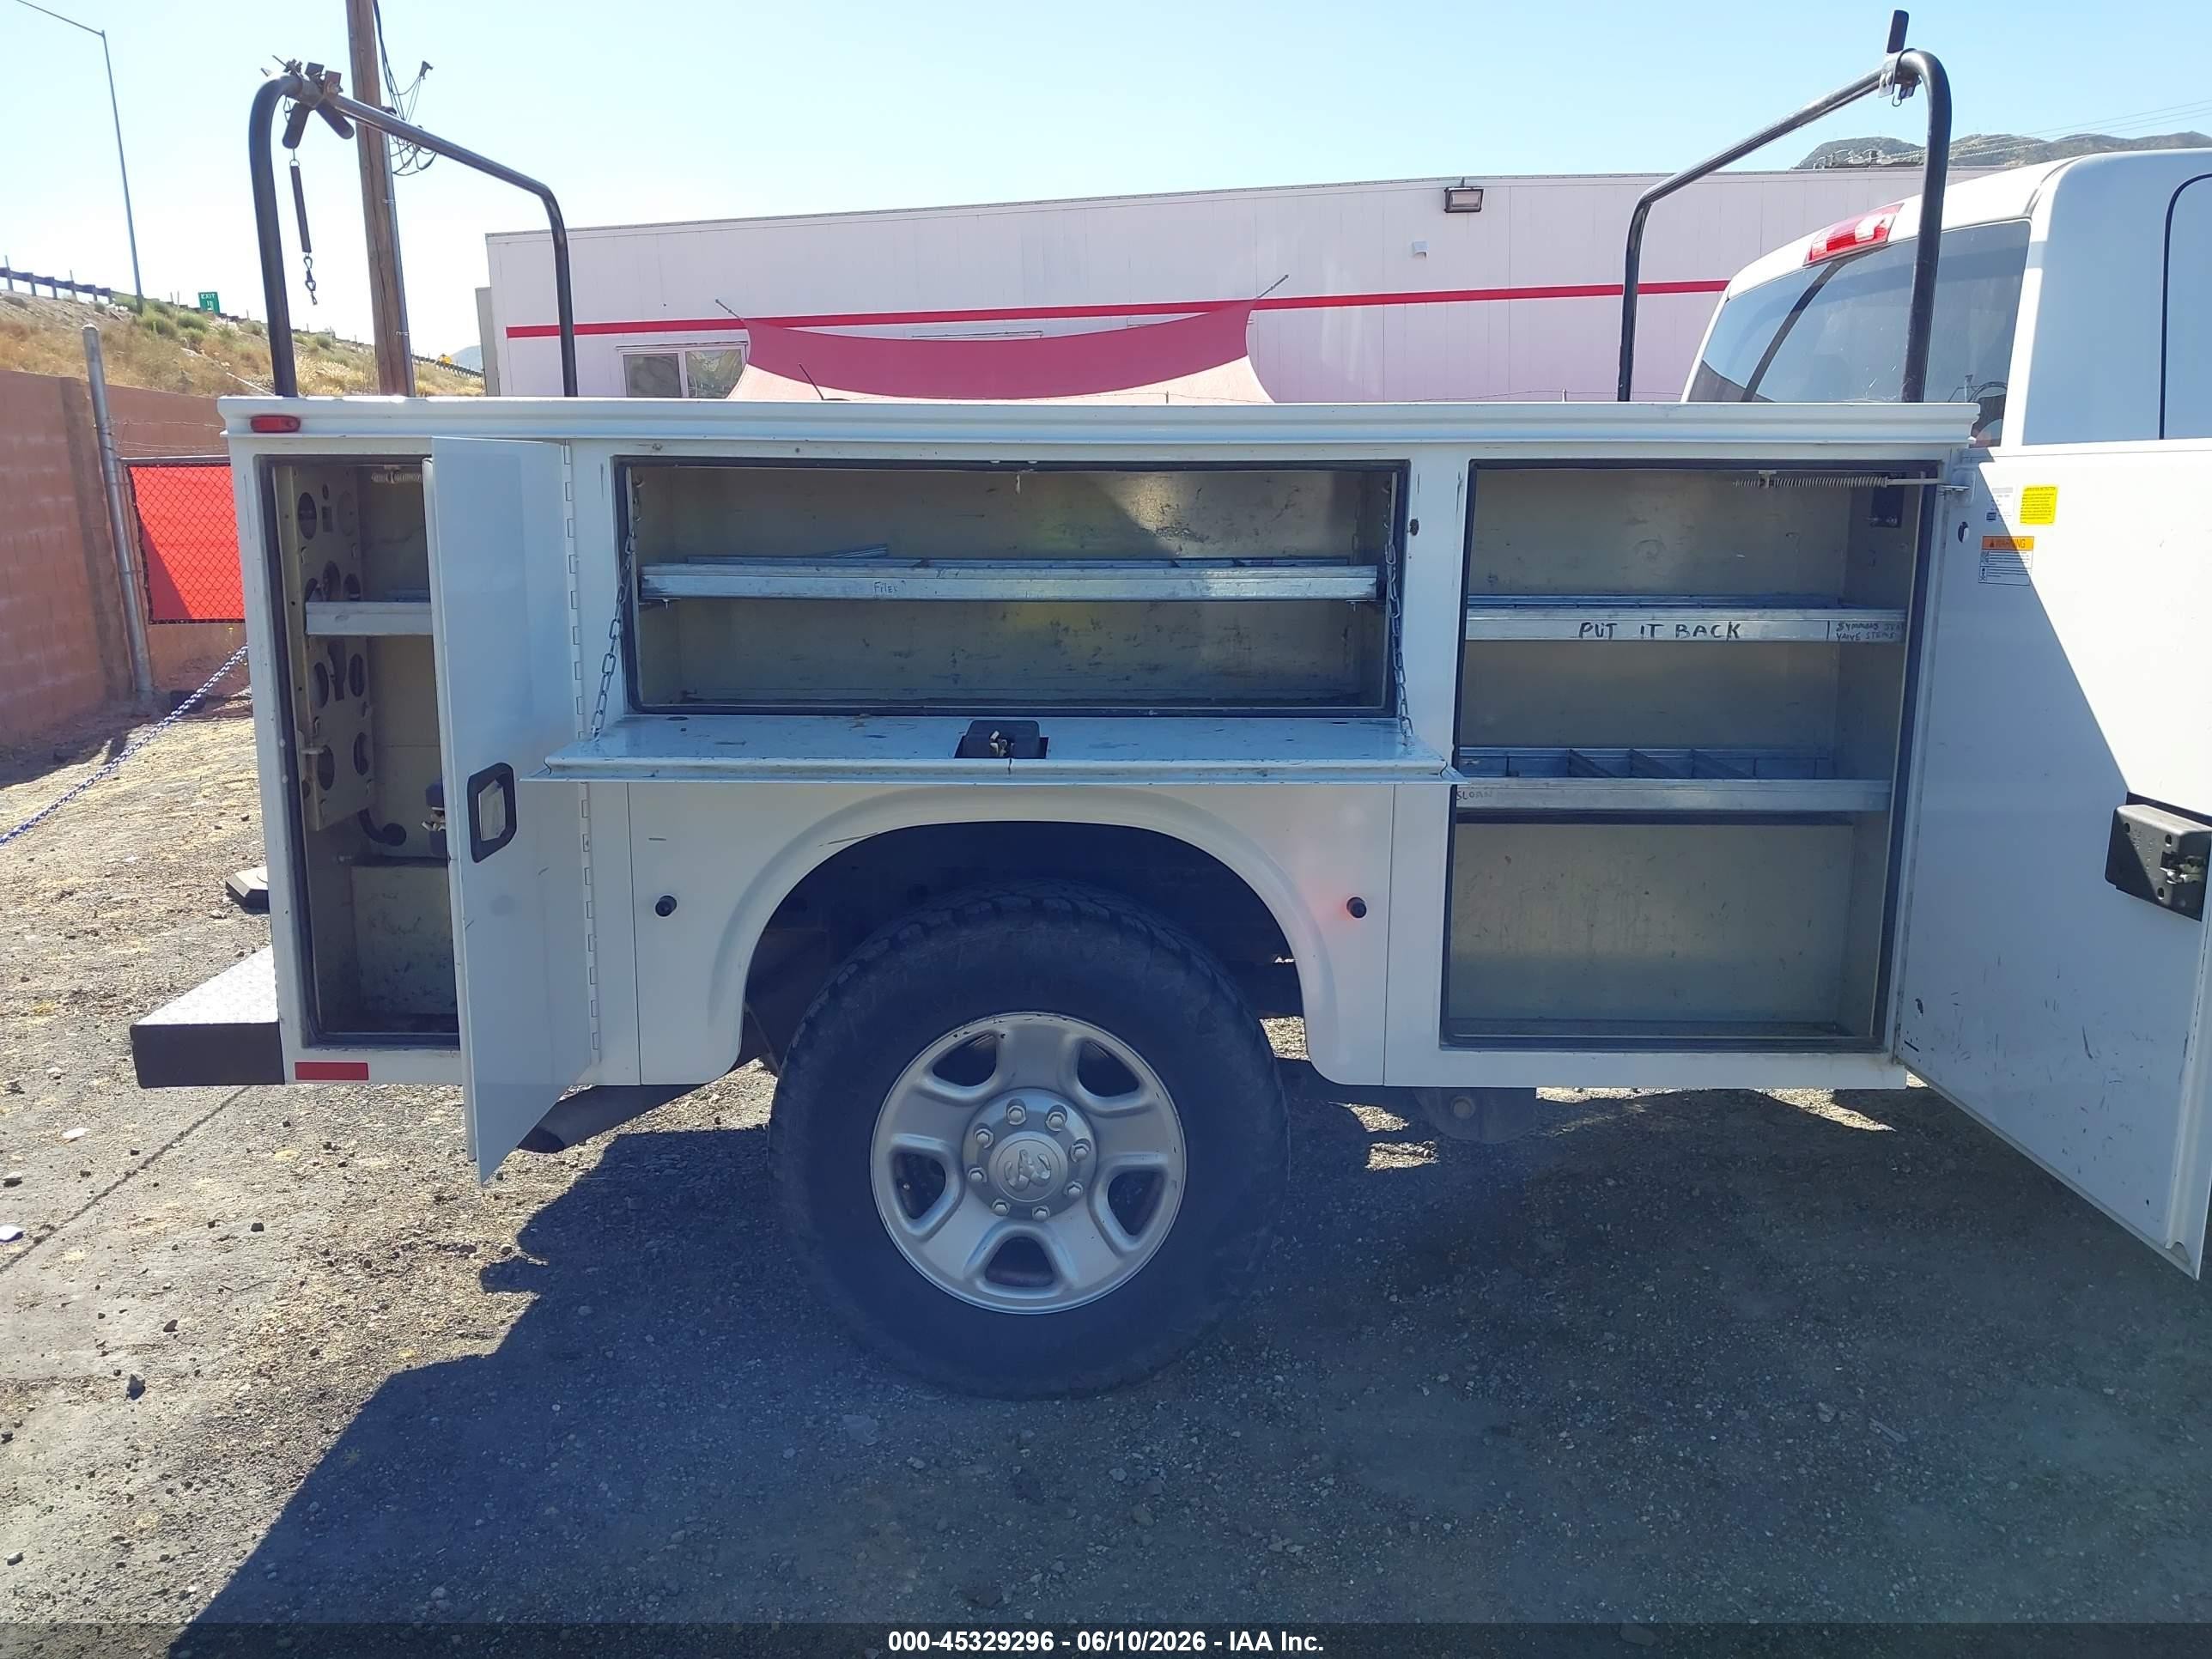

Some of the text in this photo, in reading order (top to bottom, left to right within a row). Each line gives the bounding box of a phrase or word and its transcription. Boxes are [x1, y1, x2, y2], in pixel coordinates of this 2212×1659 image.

[1578, 621, 1741, 641] PUT IT BACK
